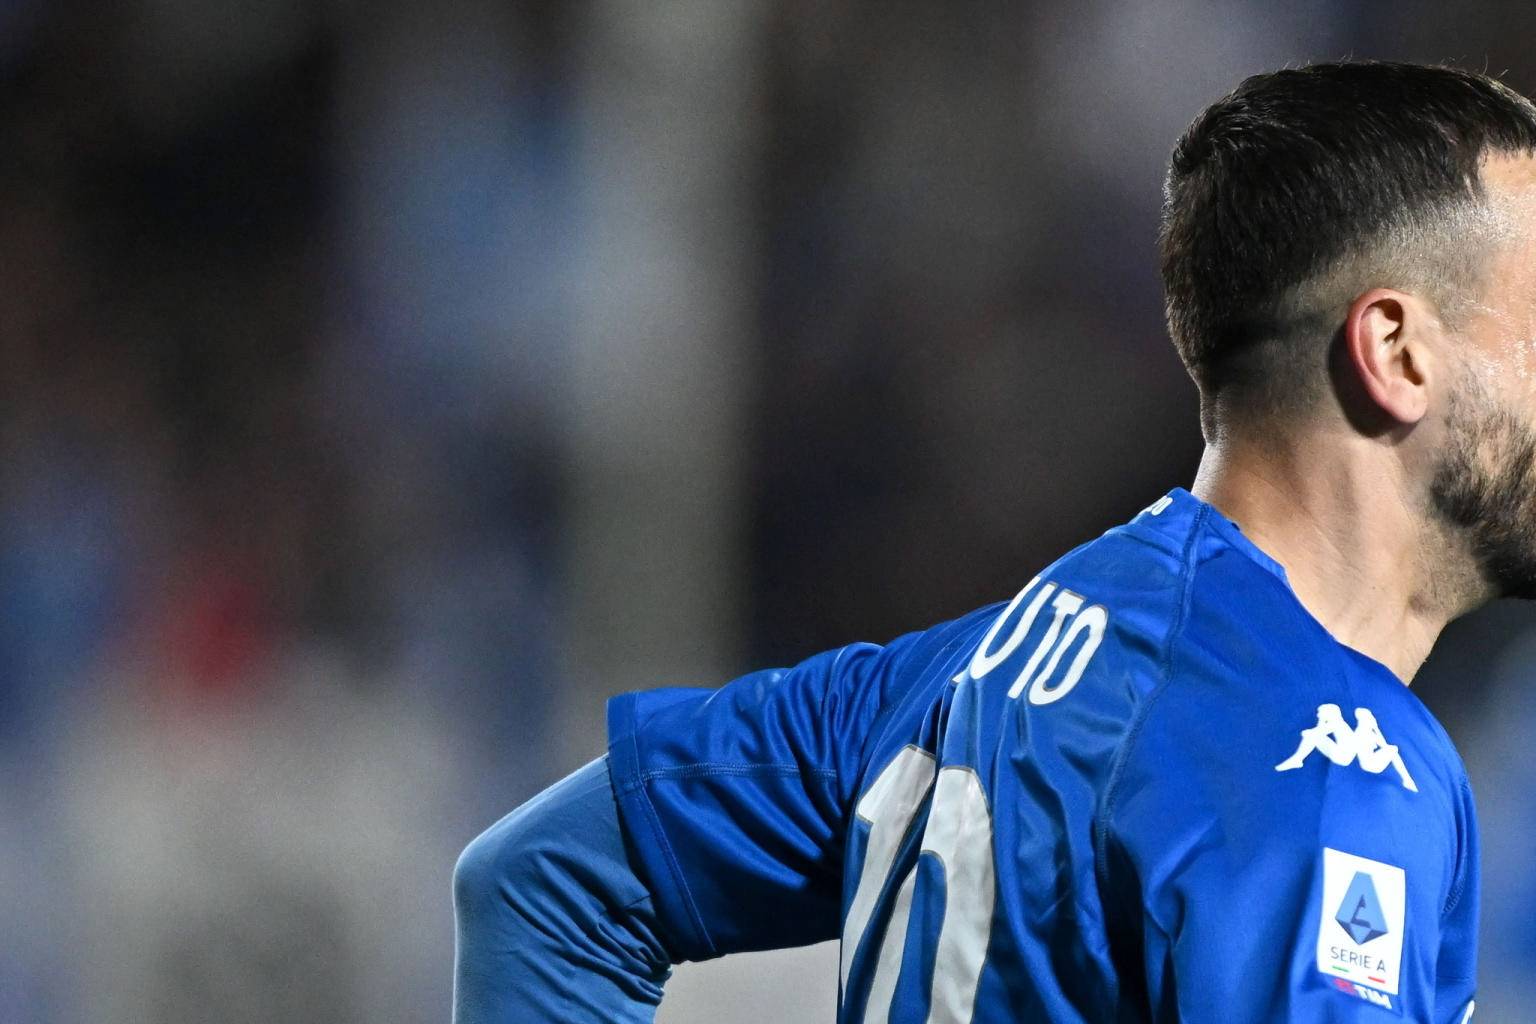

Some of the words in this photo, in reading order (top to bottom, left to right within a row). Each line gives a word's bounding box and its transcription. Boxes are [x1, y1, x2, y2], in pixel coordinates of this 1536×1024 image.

[952, 576, 1108, 705] UTO
[1331, 946, 1372, 969] SERIE
[1376, 959, 1386, 973] A
